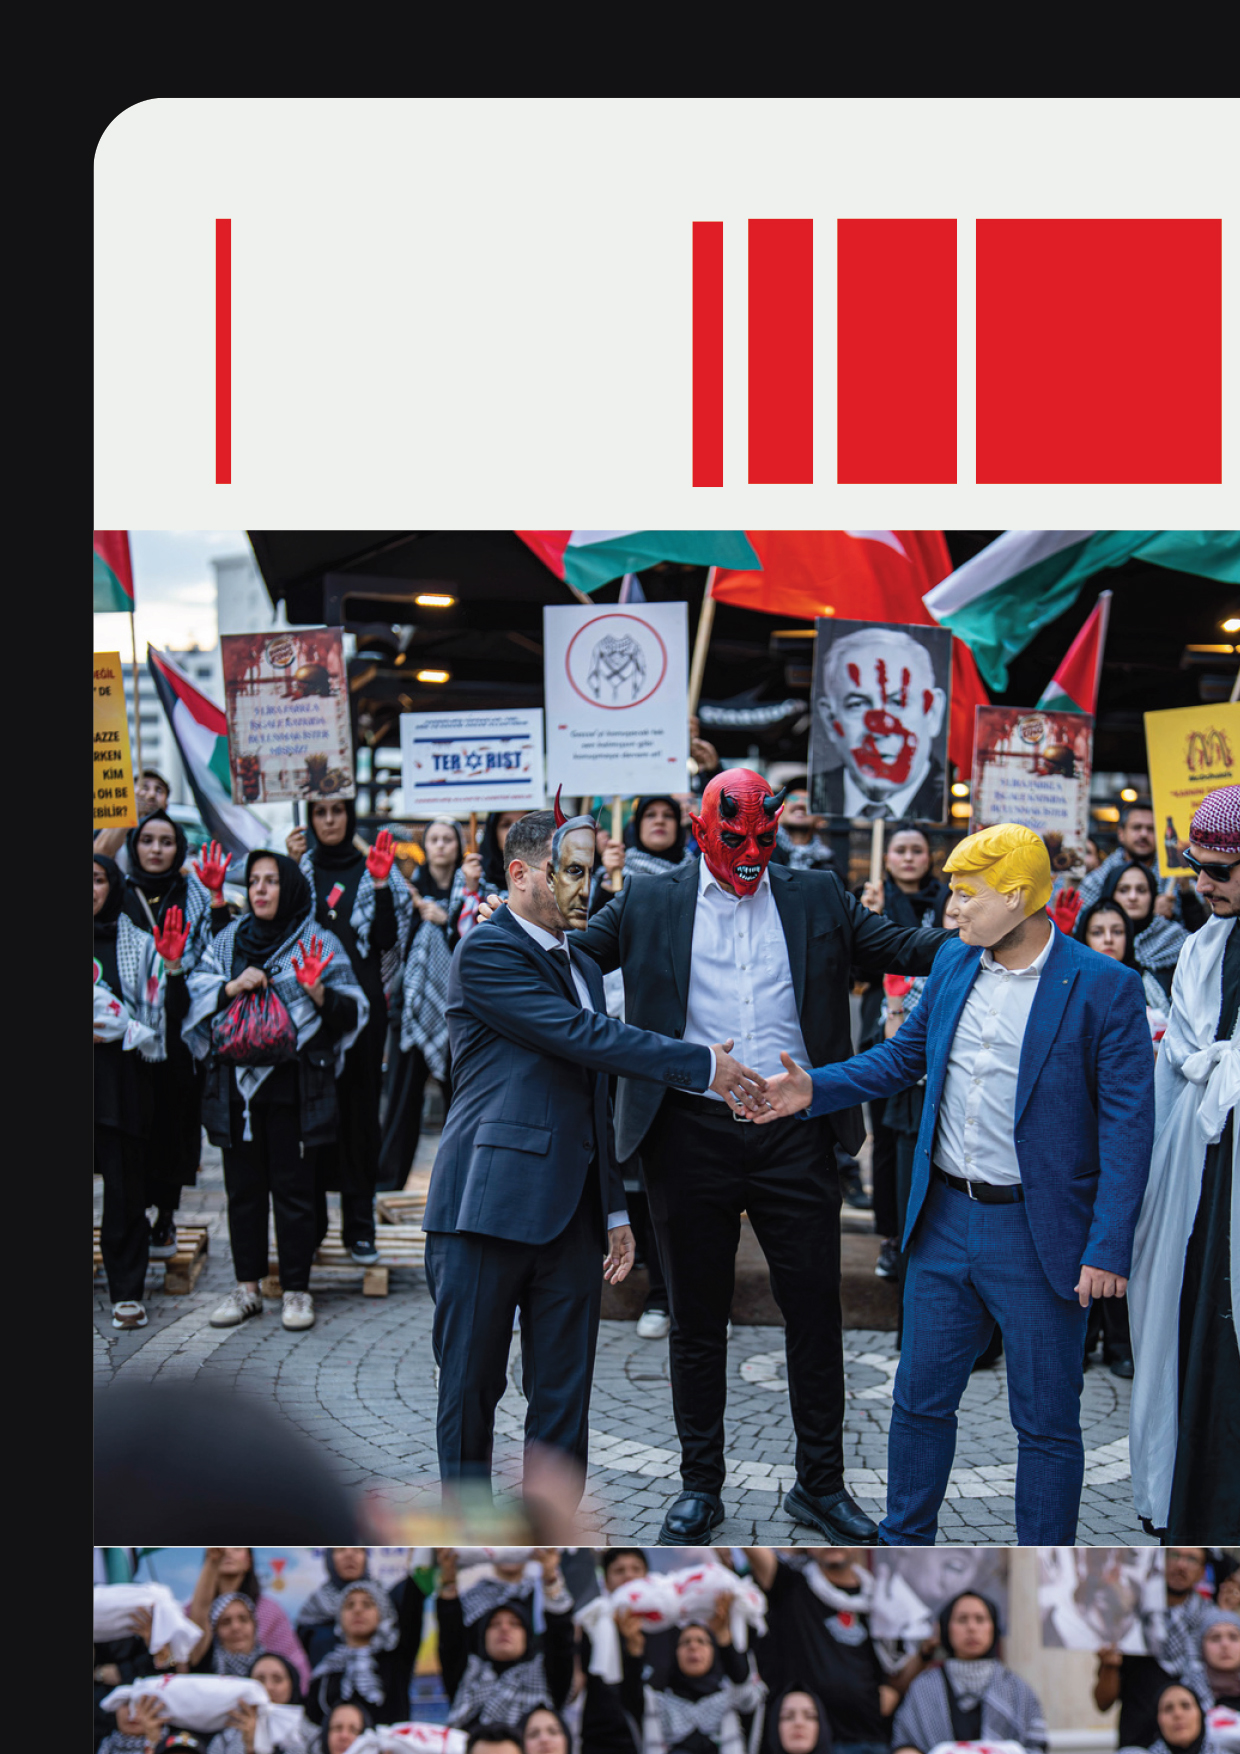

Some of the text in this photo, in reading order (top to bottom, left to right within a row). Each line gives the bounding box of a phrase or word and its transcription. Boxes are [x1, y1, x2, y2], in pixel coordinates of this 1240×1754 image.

[93, 731, 120, 743] AZZE
[103, 766, 124, 780] KİM
[97, 786, 129, 799] OH BE
